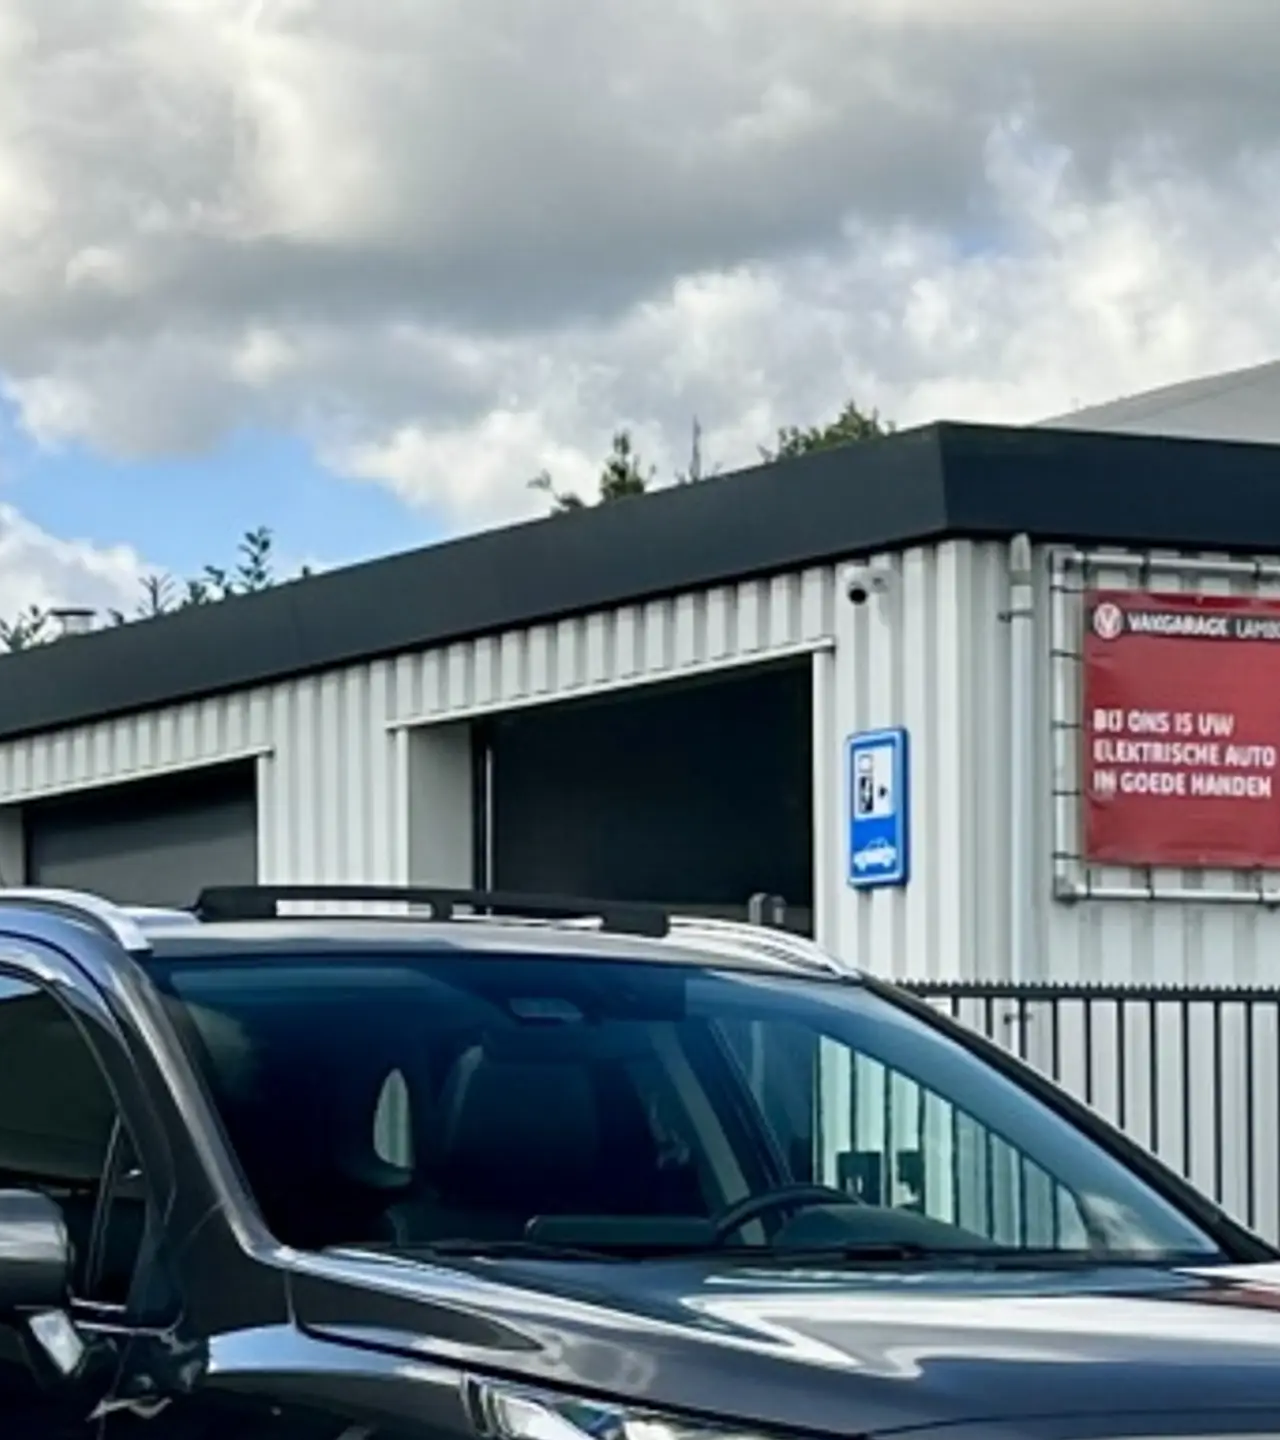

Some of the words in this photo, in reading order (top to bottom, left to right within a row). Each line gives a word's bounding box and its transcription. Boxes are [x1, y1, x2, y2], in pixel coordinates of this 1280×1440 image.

[1128, 611, 1228, 637] VAKGARAGE
[1128, 710, 1169, 734] ONS
[1175, 712, 1193, 734] IS
[1198, 713, 1234, 737] UW
[1093, 738, 1219, 765] ELEKTRISCHE
[1224, 745, 1276, 767] AUTO
[1093, 769, 1117, 792] IN
[1121, 772, 1185, 794] GOEDE
[1191, 773, 1272, 797] HANDEN
